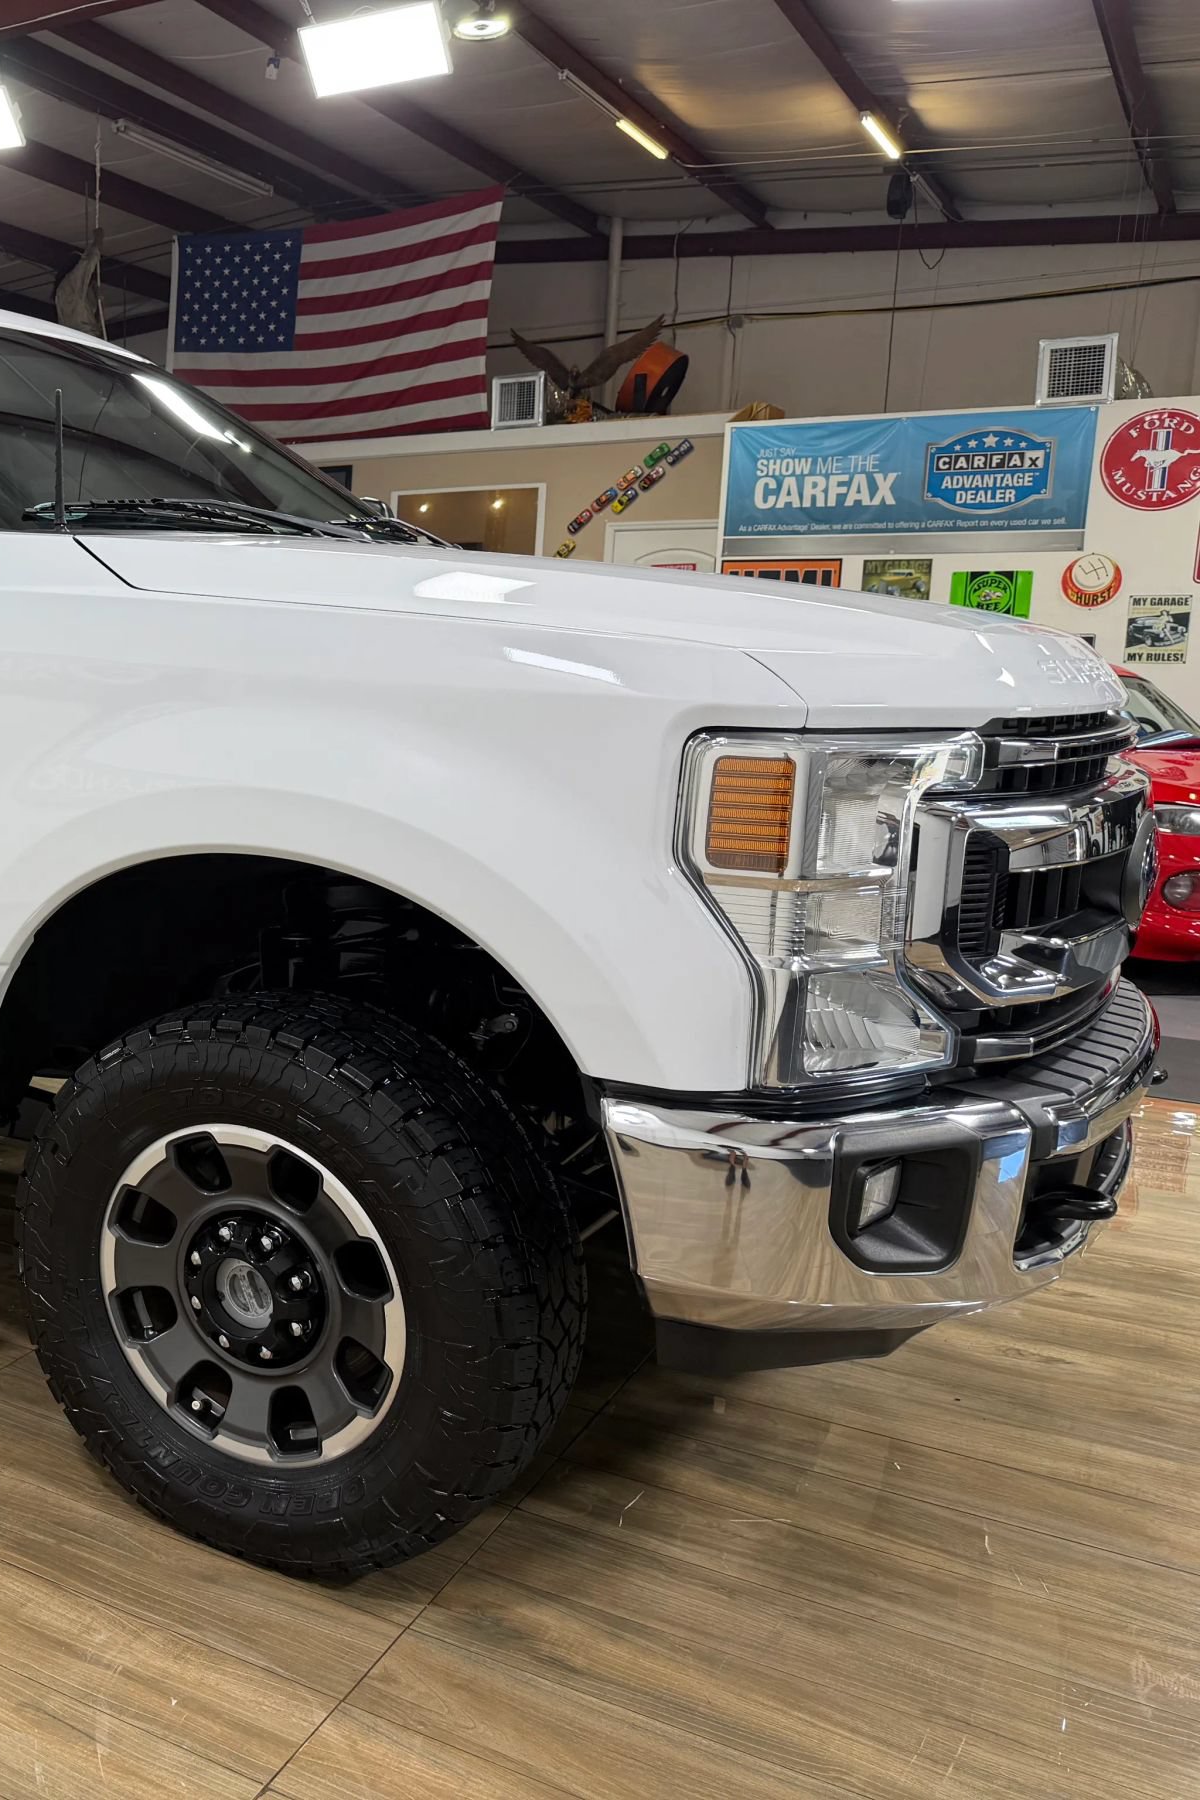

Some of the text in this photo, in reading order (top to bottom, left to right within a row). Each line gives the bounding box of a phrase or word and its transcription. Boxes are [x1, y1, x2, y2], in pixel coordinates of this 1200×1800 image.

[1129, 417, 1195, 438] FORD
[758, 448, 778, 458] JUST
[756, 454, 881, 477] SHOW ME THE
[938, 453, 1040, 470] CARFAX
[754, 473, 897, 510] CARFAX
[1112, 466, 1200, 502] MUSTANG
[955, 489, 1016, 504] DEALER
[854, 521, 887, 530] committed
[895, 521, 919, 531] offering
[956, 519, 978, 529] Report
[990, 519, 1008, 528] every
[1010, 518, 1026, 526] used
[865, 560, 931, 574] MY GARAGE
[973, 578, 1008, 593] SUPER
[1075, 587, 1112, 606] HURST
[1132, 597, 1190, 606] MY GARAGE
[1127, 652, 1184, 662] MY RULES!
[89, 1374, 367, 1517] OPEN COUNTRY
